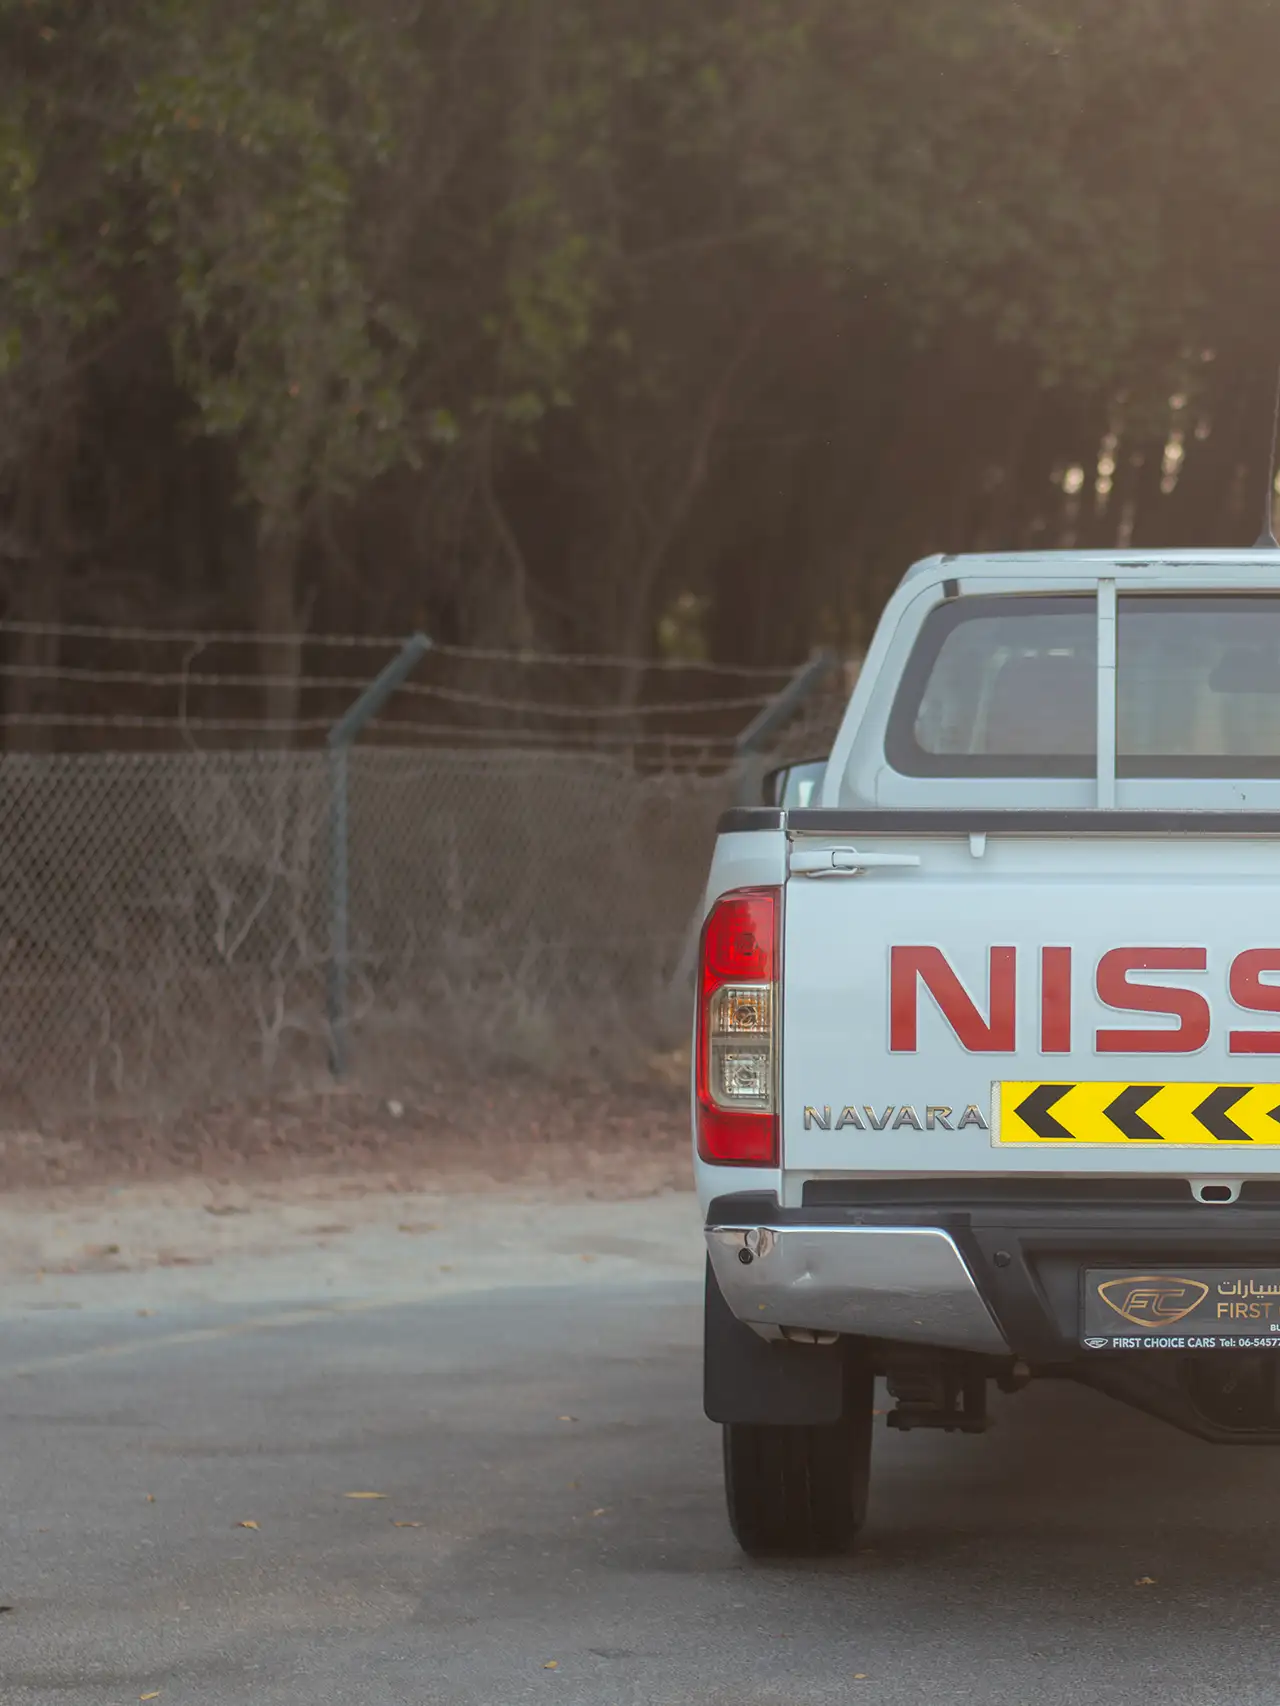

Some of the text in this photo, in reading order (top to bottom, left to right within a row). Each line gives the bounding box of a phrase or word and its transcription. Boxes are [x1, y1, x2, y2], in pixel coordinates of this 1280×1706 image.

[803, 1104, 989, 1132] NAVARA
[1216, 1302, 1274, 1319] FIRST
[1112, 1337, 1142, 1348] FIRST
[1143, 1337, 1185, 1348] CHOICE
[1187, 1337, 1216, 1348] CARS
[1219, 1338, 1236, 1347] Tel:
